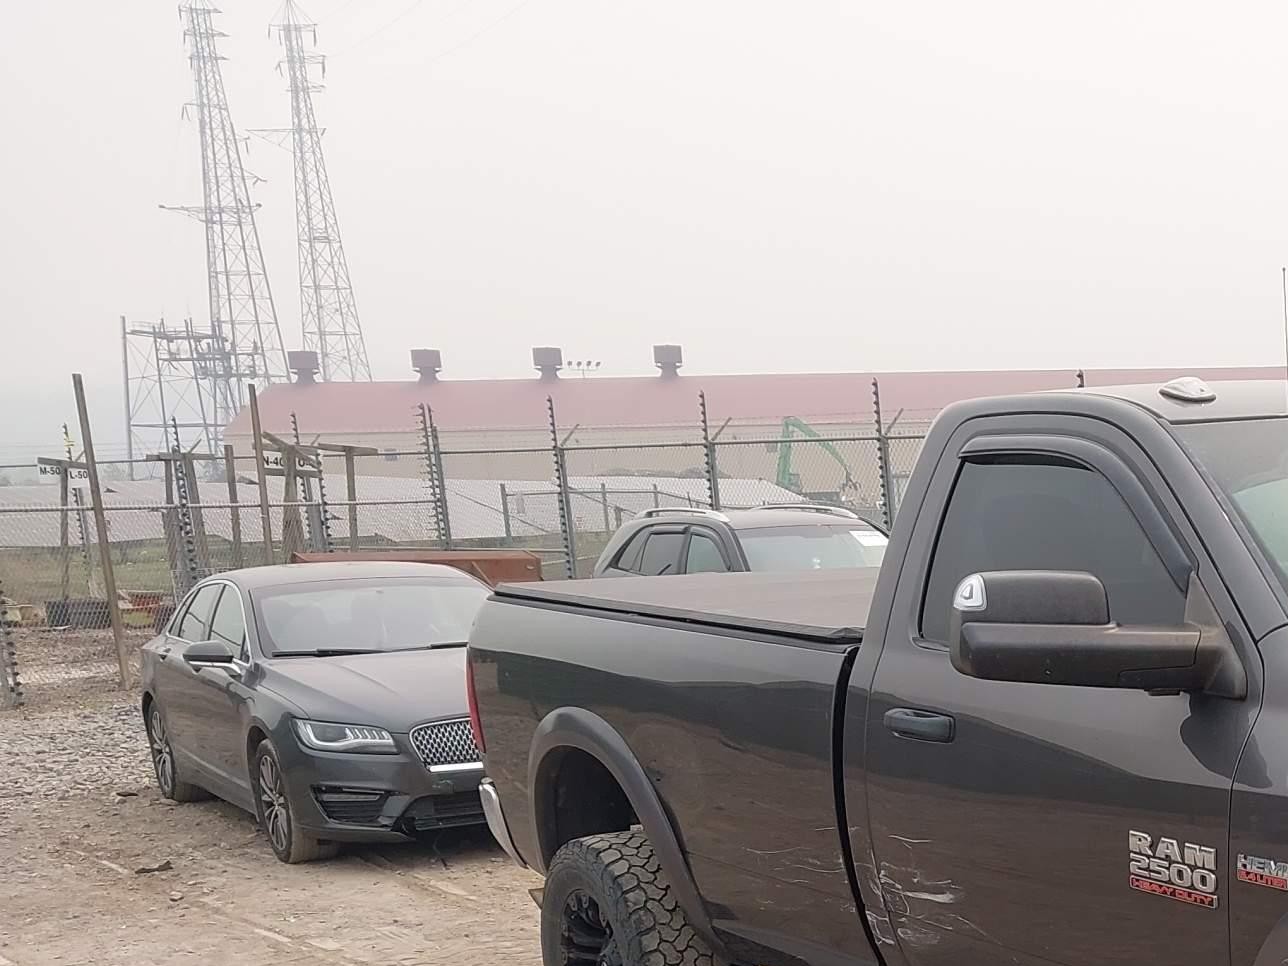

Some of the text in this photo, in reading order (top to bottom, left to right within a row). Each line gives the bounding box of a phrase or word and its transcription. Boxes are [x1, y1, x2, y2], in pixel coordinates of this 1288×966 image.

[69, 470, 88, 479] L-50
[1129, 830, 1217, 870] RAM
[1130, 853, 1216, 893] 2500
[1132, 878, 1213, 905] HEAVY DUTY
